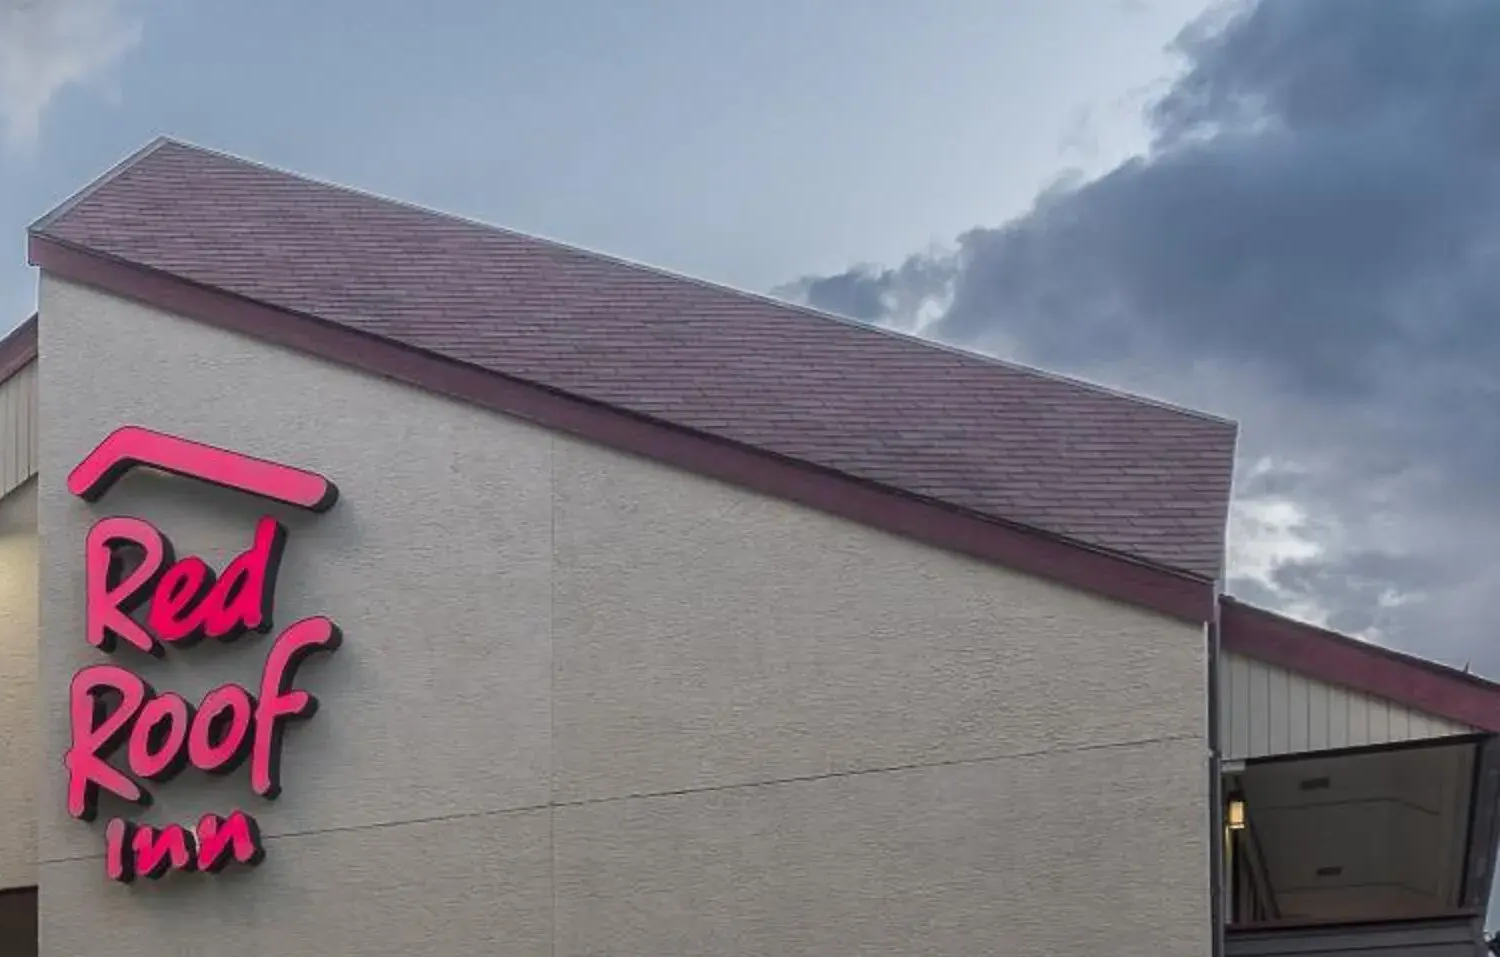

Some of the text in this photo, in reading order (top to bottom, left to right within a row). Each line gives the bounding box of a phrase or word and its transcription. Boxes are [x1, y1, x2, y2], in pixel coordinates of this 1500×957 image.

[85, 515, 283, 656] Red
[65, 616, 338, 820] Roof
[105, 810, 263, 882] Inn
